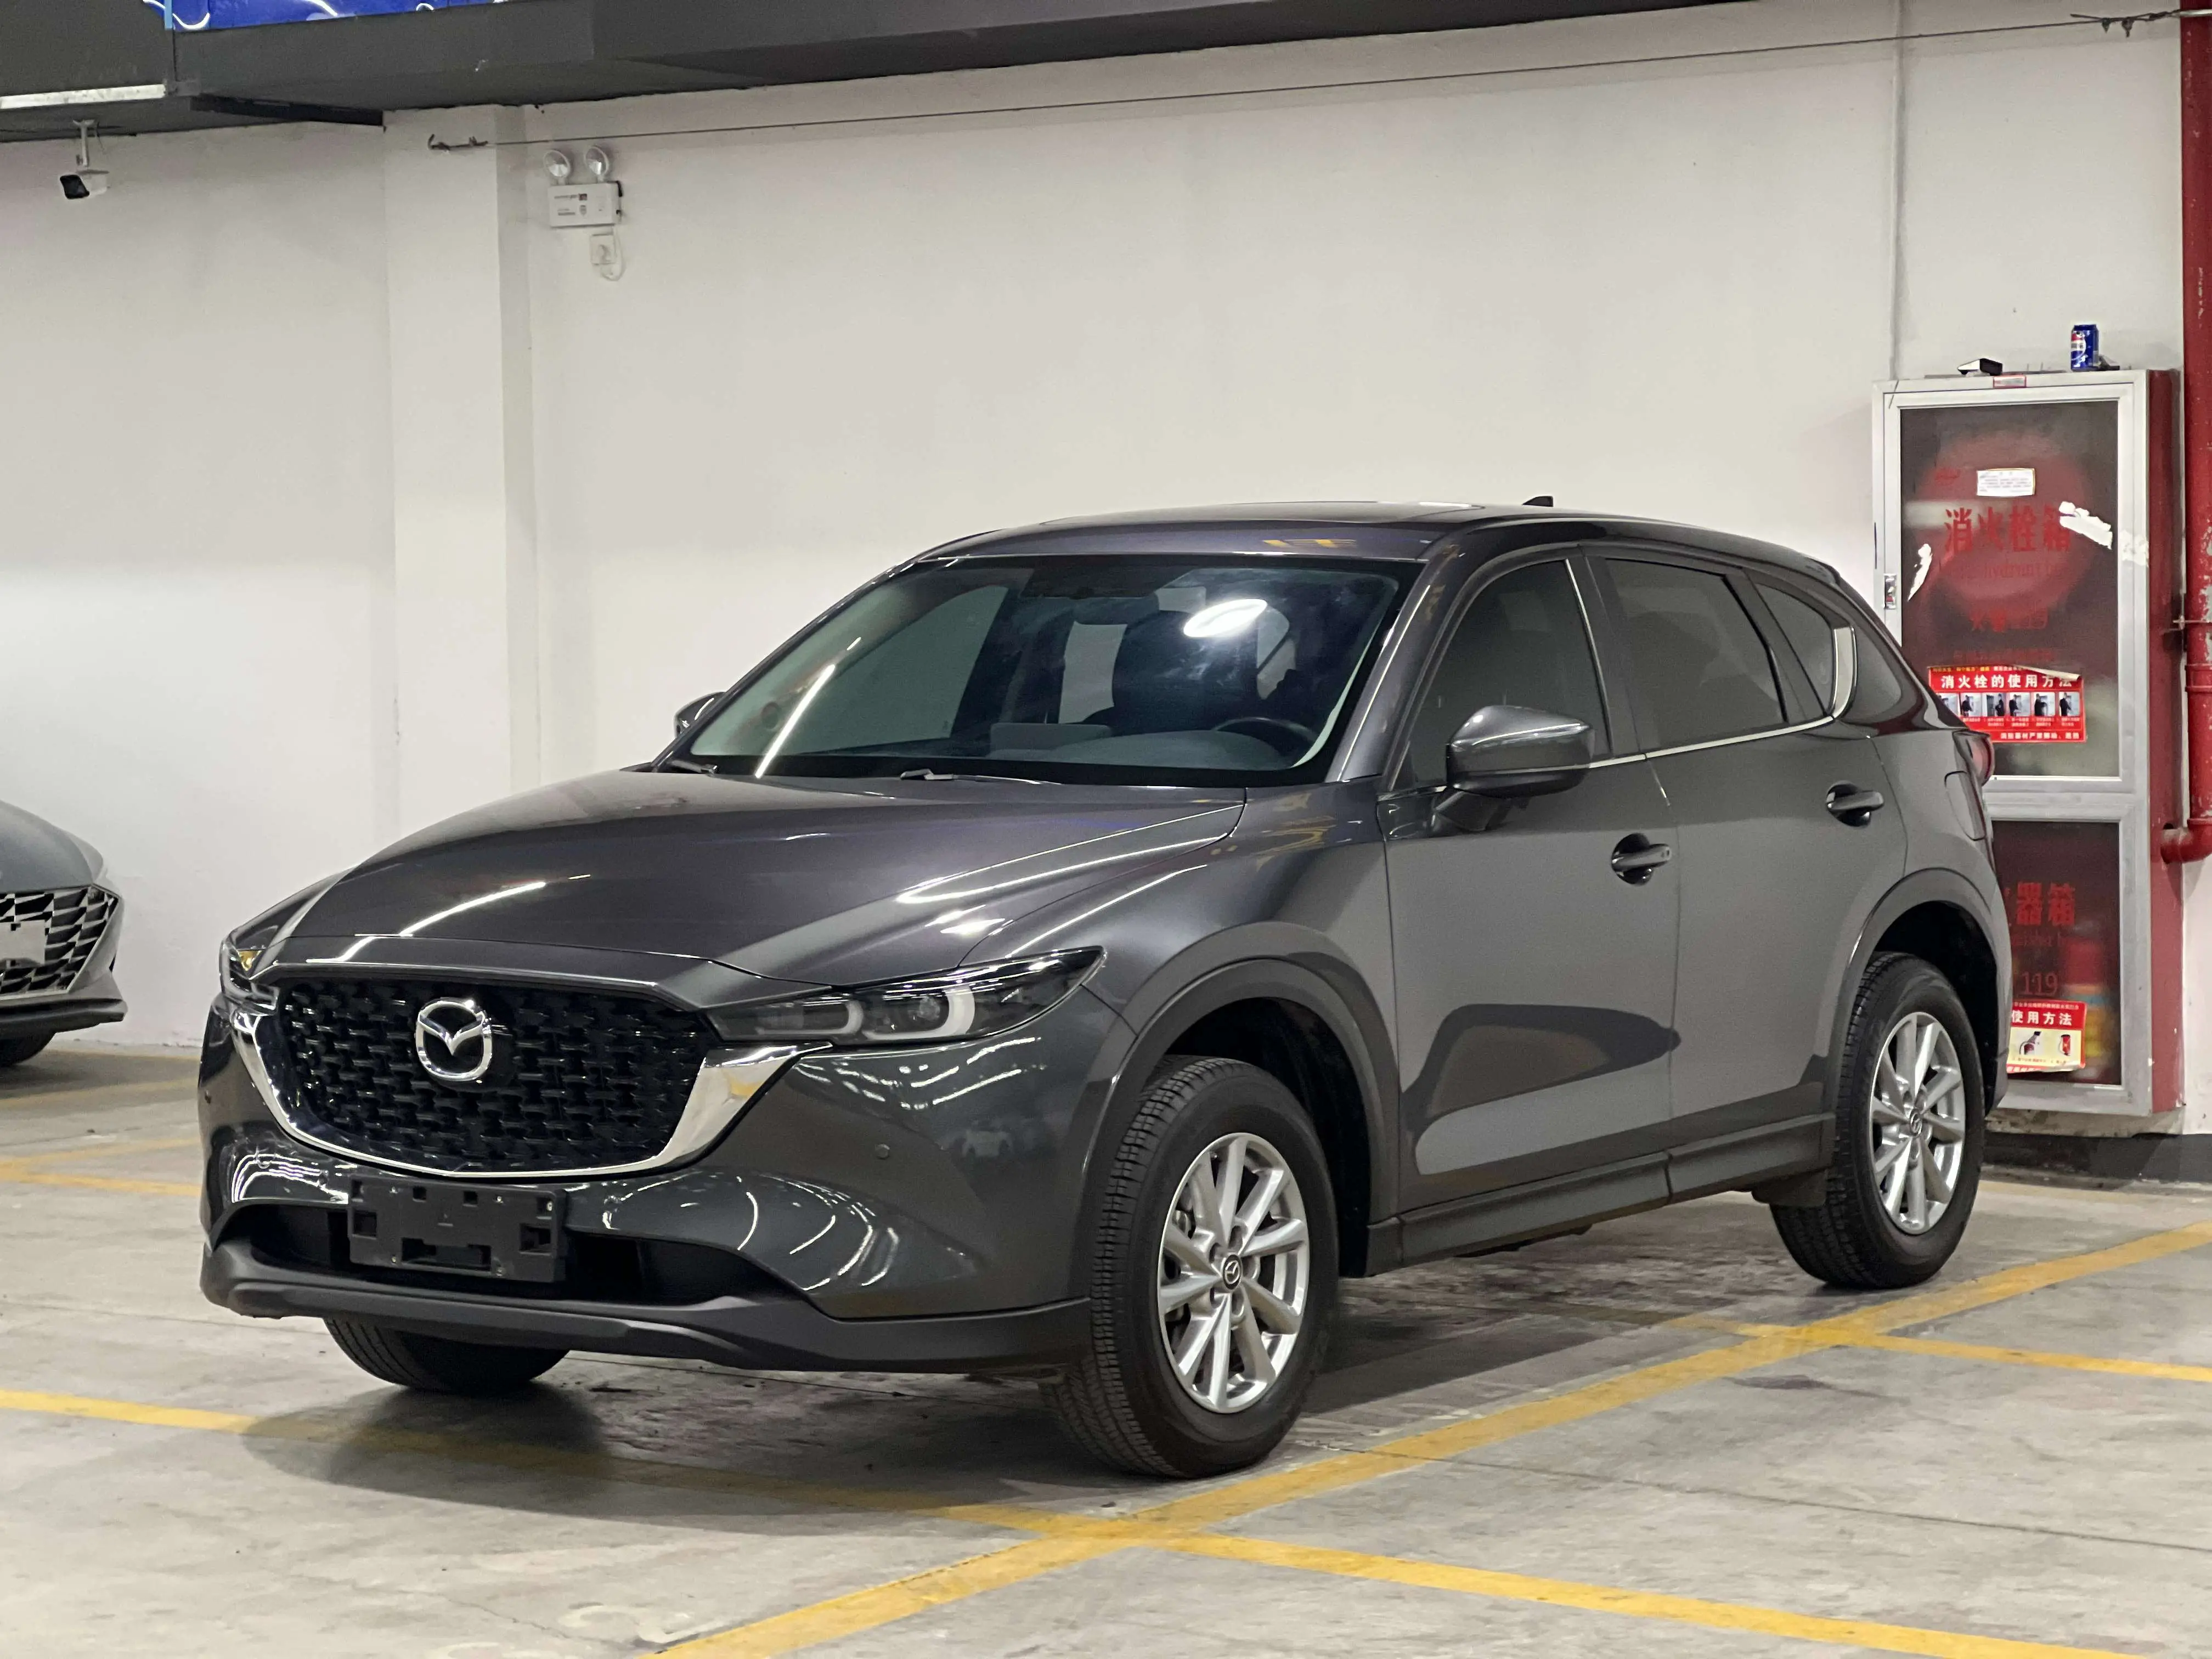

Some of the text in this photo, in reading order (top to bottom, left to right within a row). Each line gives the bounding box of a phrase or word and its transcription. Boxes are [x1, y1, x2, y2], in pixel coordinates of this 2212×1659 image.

[1941, 674, 2072, 689] 消火栓的使用方法
[2005, 882, 2075, 926] 器箱
[2022, 972, 2057, 996] 119
[2012, 1009, 2072, 1025] 使用方法
